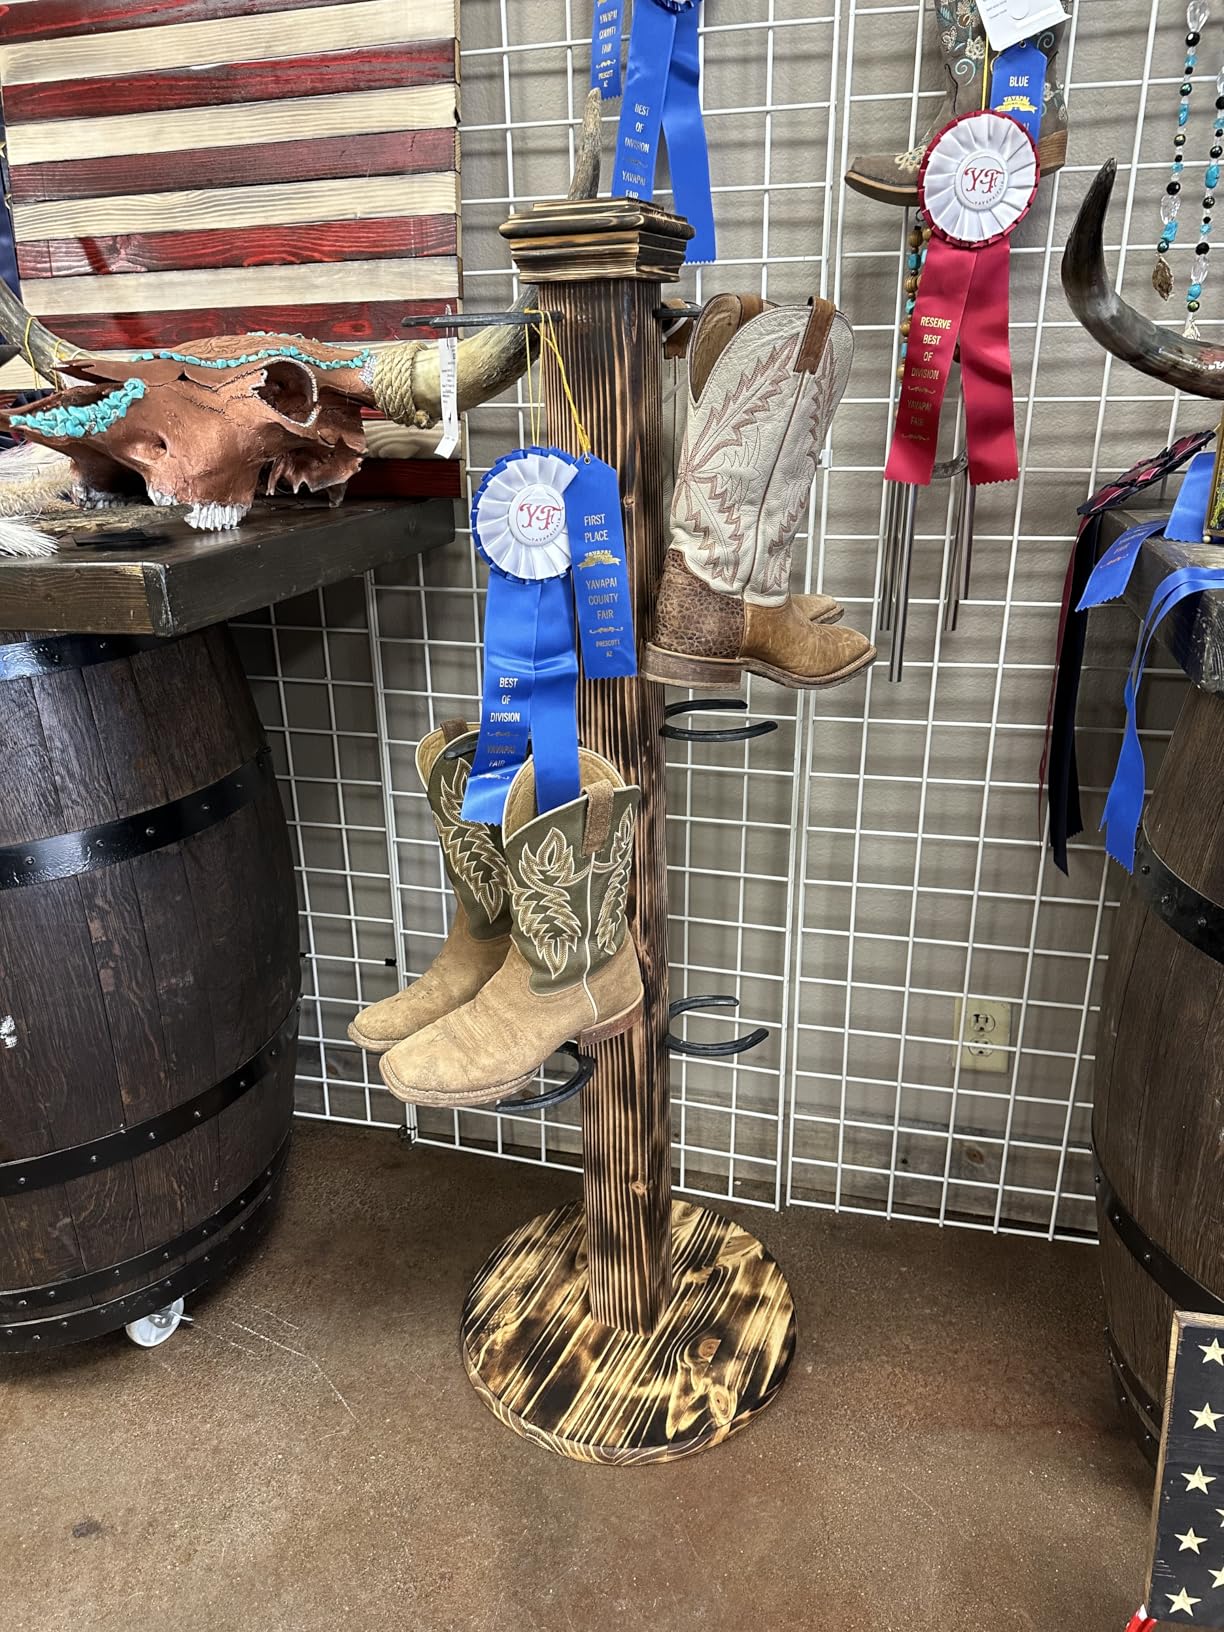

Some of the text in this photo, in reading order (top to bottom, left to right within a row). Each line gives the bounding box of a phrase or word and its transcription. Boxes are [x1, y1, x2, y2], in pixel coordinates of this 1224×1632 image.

[1009, 76, 1029, 87] BLUE
[634, 103, 650, 116] BEST
[635, 121, 645, 133] OF
[624, 136, 649, 153] DIVISION
[622, 170, 646, 186] YAVAPAI
[625, 189, 639, 199] FAIR
[920, 316, 951, 329] RESERVE
[922, 334, 941, 344] BEST
[923, 351, 933, 361] OF
[911, 367, 940, 380] DIVISION
[907, 399, 932, 413] YAVAPAI
[584, 514, 606, 526] FIRST
[584, 530, 608, 543] PLACE
[586, 577, 618, 590] YAVAPAI
[588, 593, 619, 606] COUNTY
[596, 609, 614, 620] FAIR
[499, 677, 518, 688] BEST
[501, 695, 511, 704] OF
[490, 712, 520, 722] DIVISION
